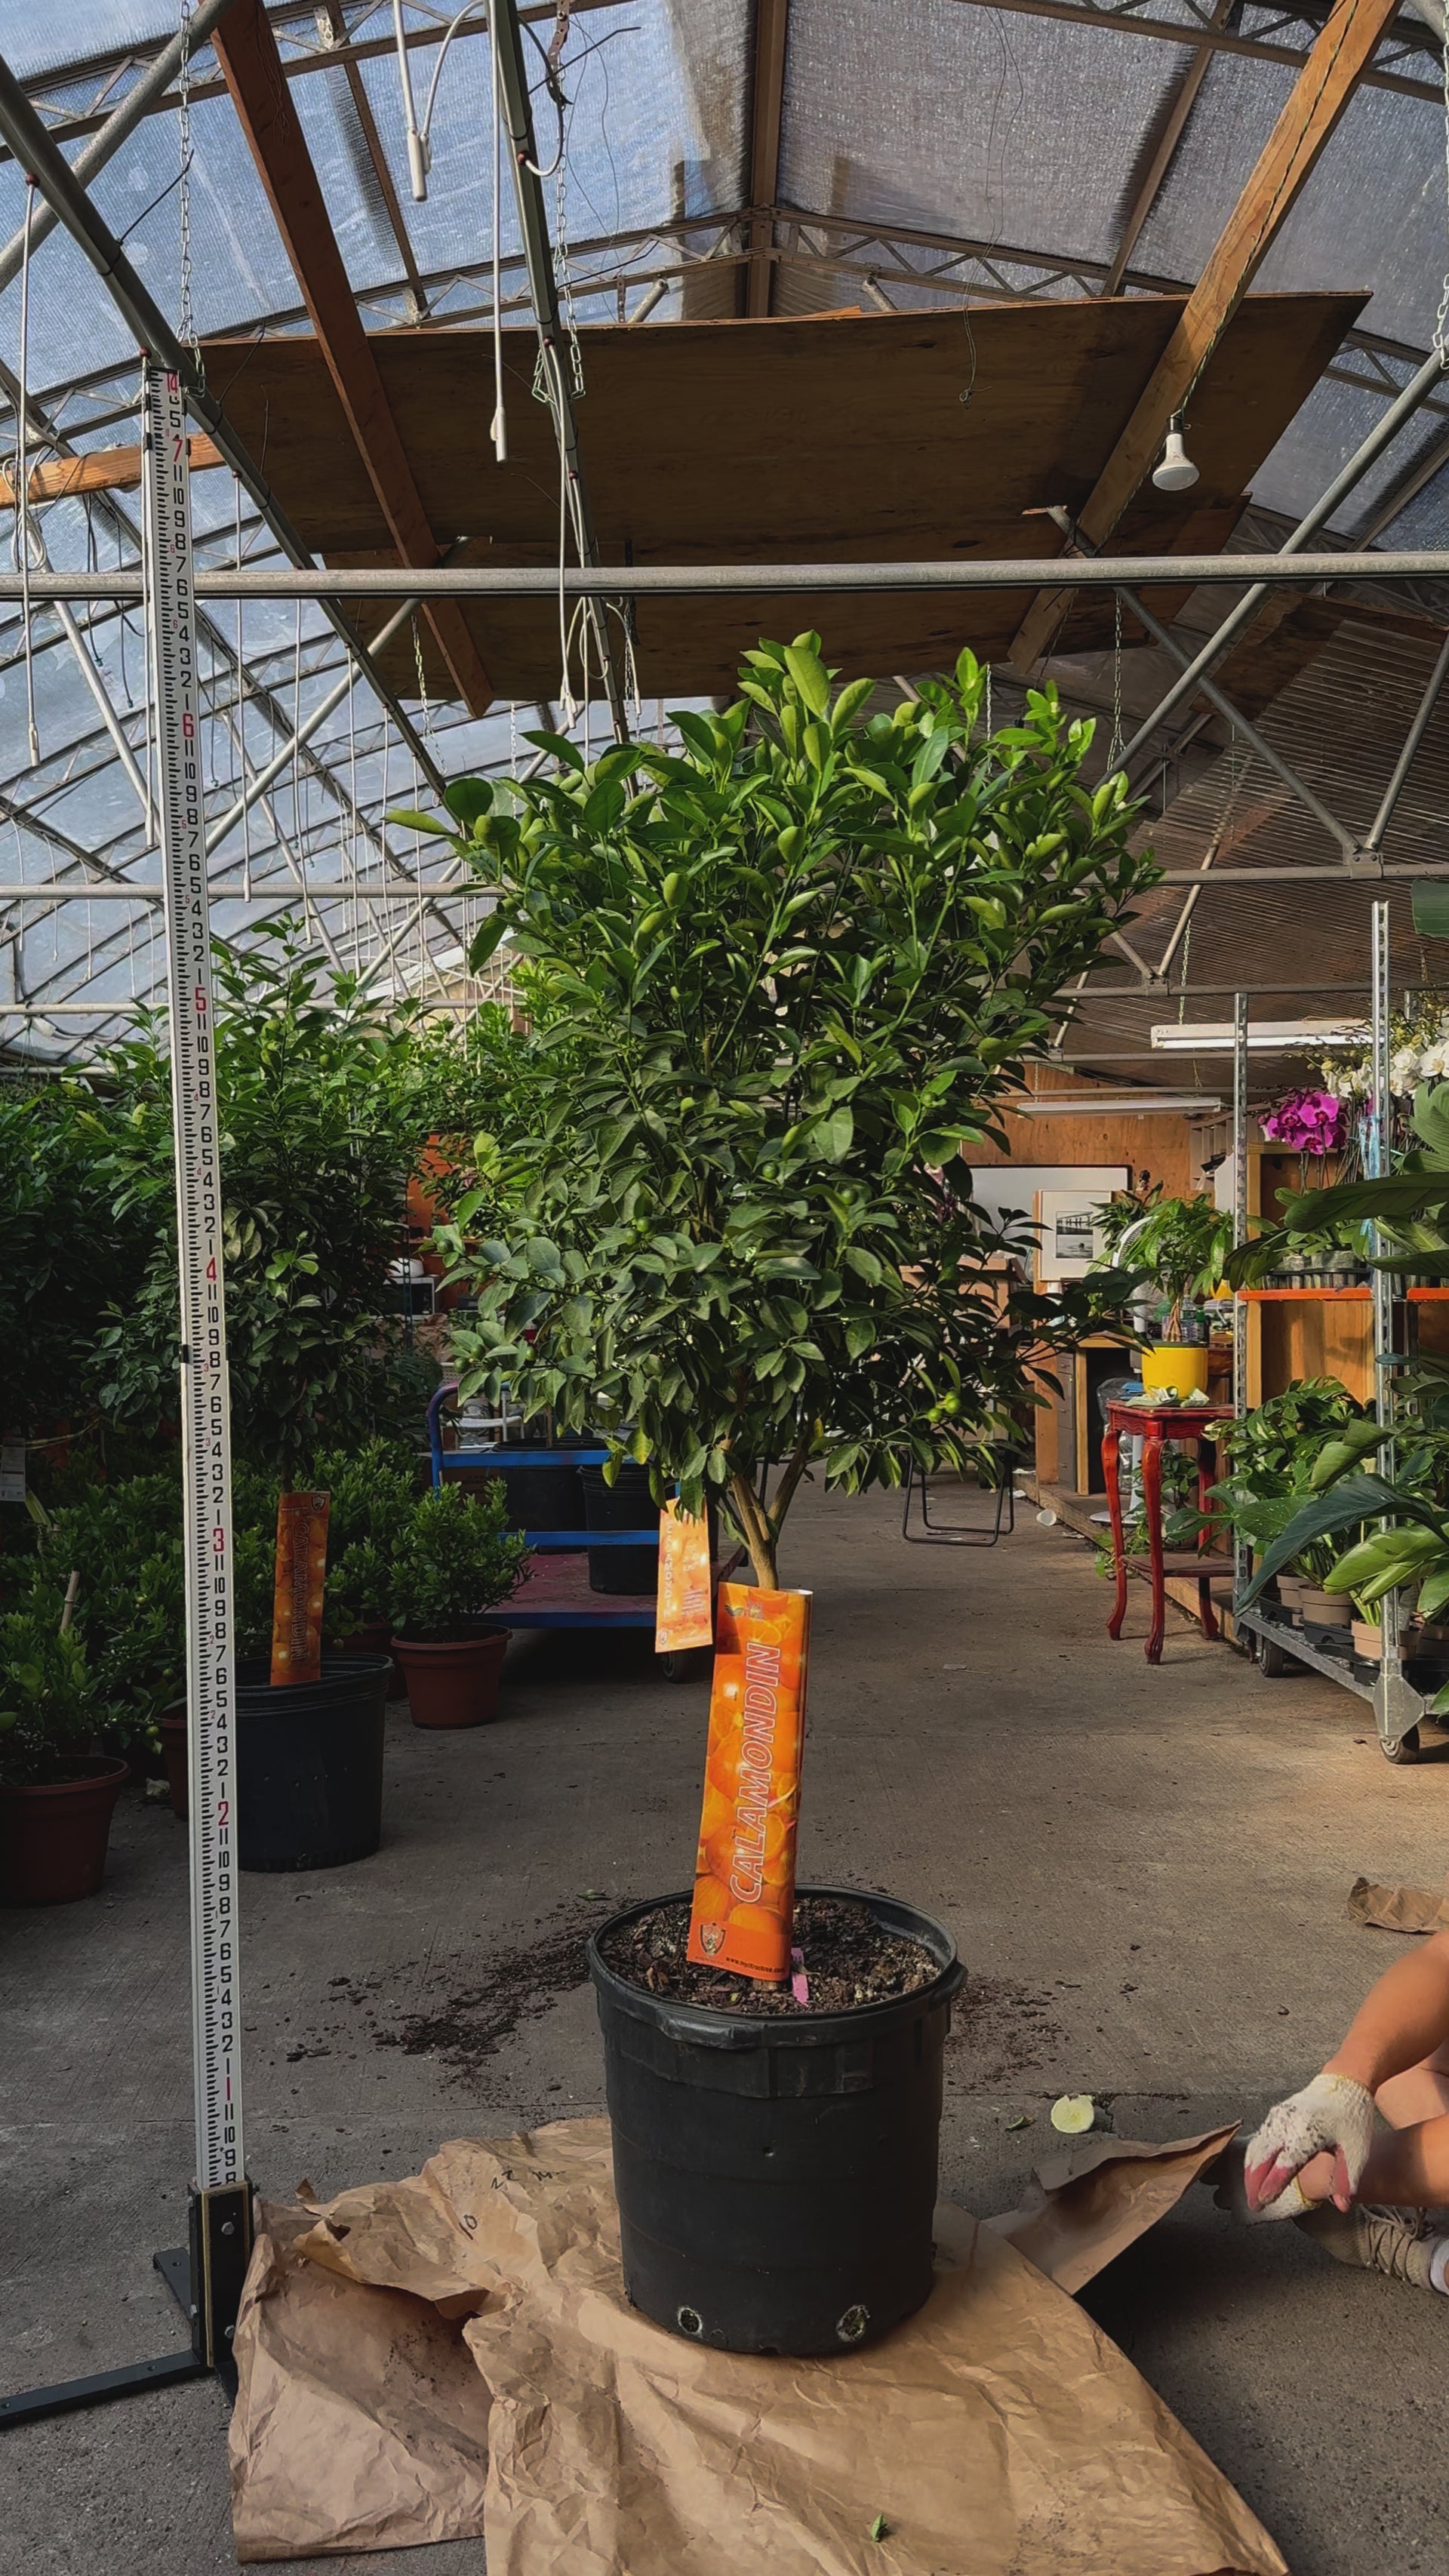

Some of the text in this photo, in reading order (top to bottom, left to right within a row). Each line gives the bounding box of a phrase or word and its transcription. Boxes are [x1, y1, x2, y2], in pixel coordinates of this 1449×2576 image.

[170, 410, 181, 428] 5
[172, 439, 183, 462] 7
[174, 464, 182, 482] 11
[174, 488, 184, 505] 10
[174, 510, 185, 528] 9
[175, 533, 186, 550] 8
[176, 556, 186, 573] 7
[177, 579, 188, 596] 6
[177, 602, 189, 619] 5
[179, 625, 189, 642] 4
[180, 648, 191, 665] 3
[180, 670, 192, 688] 2
[183, 713, 194, 737] 6
[185, 739, 194, 757] 11
[185, 762, 195, 779] 10
[186, 785, 197, 802] 9
[187, 808, 198, 825] 8
[188, 831, 198, 848] 7
[189, 854, 200, 871] 6
[190, 876, 202, 894] 5
[192, 900, 202, 916] 4
[192, 922, 203, 939] 3
[193, 945, 204, 962] 2
[195, 987, 206, 1011] 5
[198, 1013, 206, 1030] 11
[198, 1036, 208, 1052] 10
[198, 1059, 209, 1076] 9
[199, 1081, 210, 1098] 8
[200, 1103, 211, 1120] 7
[202, 1126, 212, 1143] 6
[202, 1149, 213, 1165] 5
[203, 1171, 214, 1187] 4
[204, 1194, 214, 1211] 3
[205, 1217, 215, 1233] 2
[207, 1257, 217, 1281] 4
[208, 1284, 217, 1300] 11
[208, 1306, 219, 1323] 10
[208, 1328, 219, 1346] 9
[210, 1351, 220, 1368] 8
[210, 1374, 220, 1390] 7
[211, 1396, 221, 1413] 6
[211, 1419, 222, 1436] 5
[211, 1442, 222, 1457] 4
[212, 1463, 223, 1481] 3
[213, 1487, 223, 1503] 2
[213, 1528, 224, 1552] 3
[215, 1554, 223, 1571] 11
[214, 1577, 225, 1594] 10
[290, 1521, 310, 1661] CALAMONDIN
[215, 1599, 226, 1617] 9
[215, 1622, 226, 1639] 8
[216, 1645, 226, 1662] 7
[216, 1667, 226, 1685] 6
[217, 1690, 227, 1707] 5
[217, 1713, 227, 1730] 4
[217, 1736, 228, 1753] 3
[217, 1759, 228, 1776] 2
[730, 1642, 780, 1904] CALAMONDIN
[218, 1801, 229, 1826] 2
[220, 1827, 228, 1845] 11
[219, 1851, 229, 1869] 10
[219, 1873, 229, 1891] 9
[220, 1897, 230, 1914] 8
[220, 1919, 231, 1937] 7
[220, 1943, 231, 1960] 6
[220, 1965, 232, 1984] 5
[221, 1989, 232, 2005] 4
[222, 2011, 232, 2030] 3
[222, 2034, 232, 2053] 2
[225, 2104, 233, 2121] 11
[224, 2126, 235, 2144] 10
[224, 2149, 235, 2167] 9
